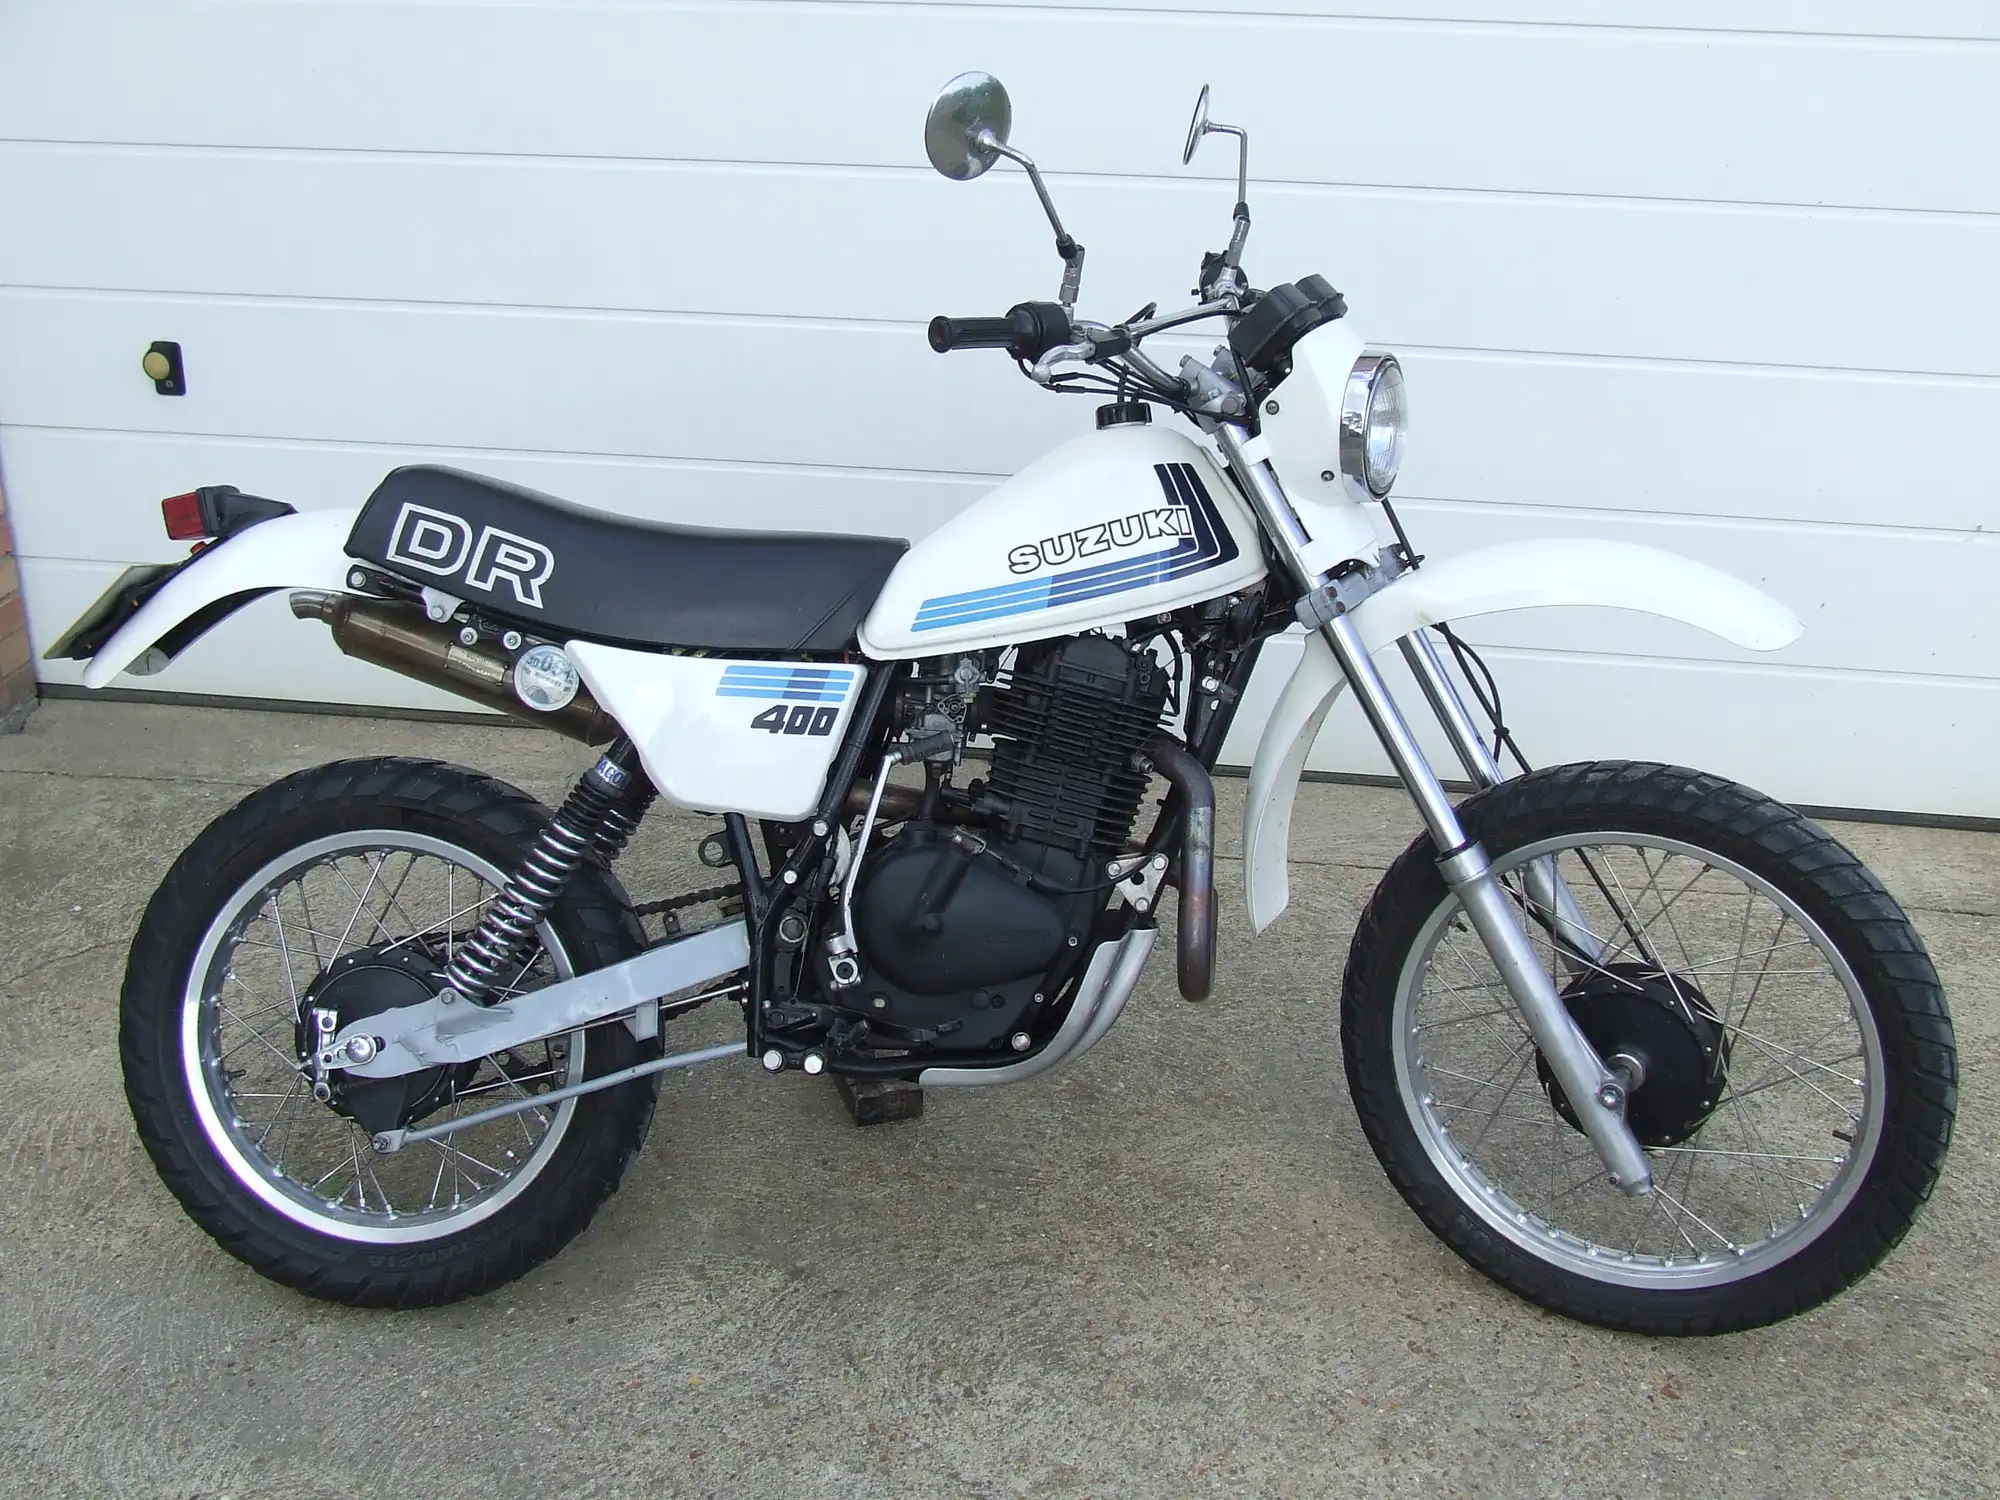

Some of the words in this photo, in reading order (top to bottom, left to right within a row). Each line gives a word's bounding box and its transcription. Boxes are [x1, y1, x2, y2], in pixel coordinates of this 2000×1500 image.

[386, 502, 555, 609] DR
[1008, 507, 1193, 574] SUZUKI
[750, 704, 840, 736] 400
